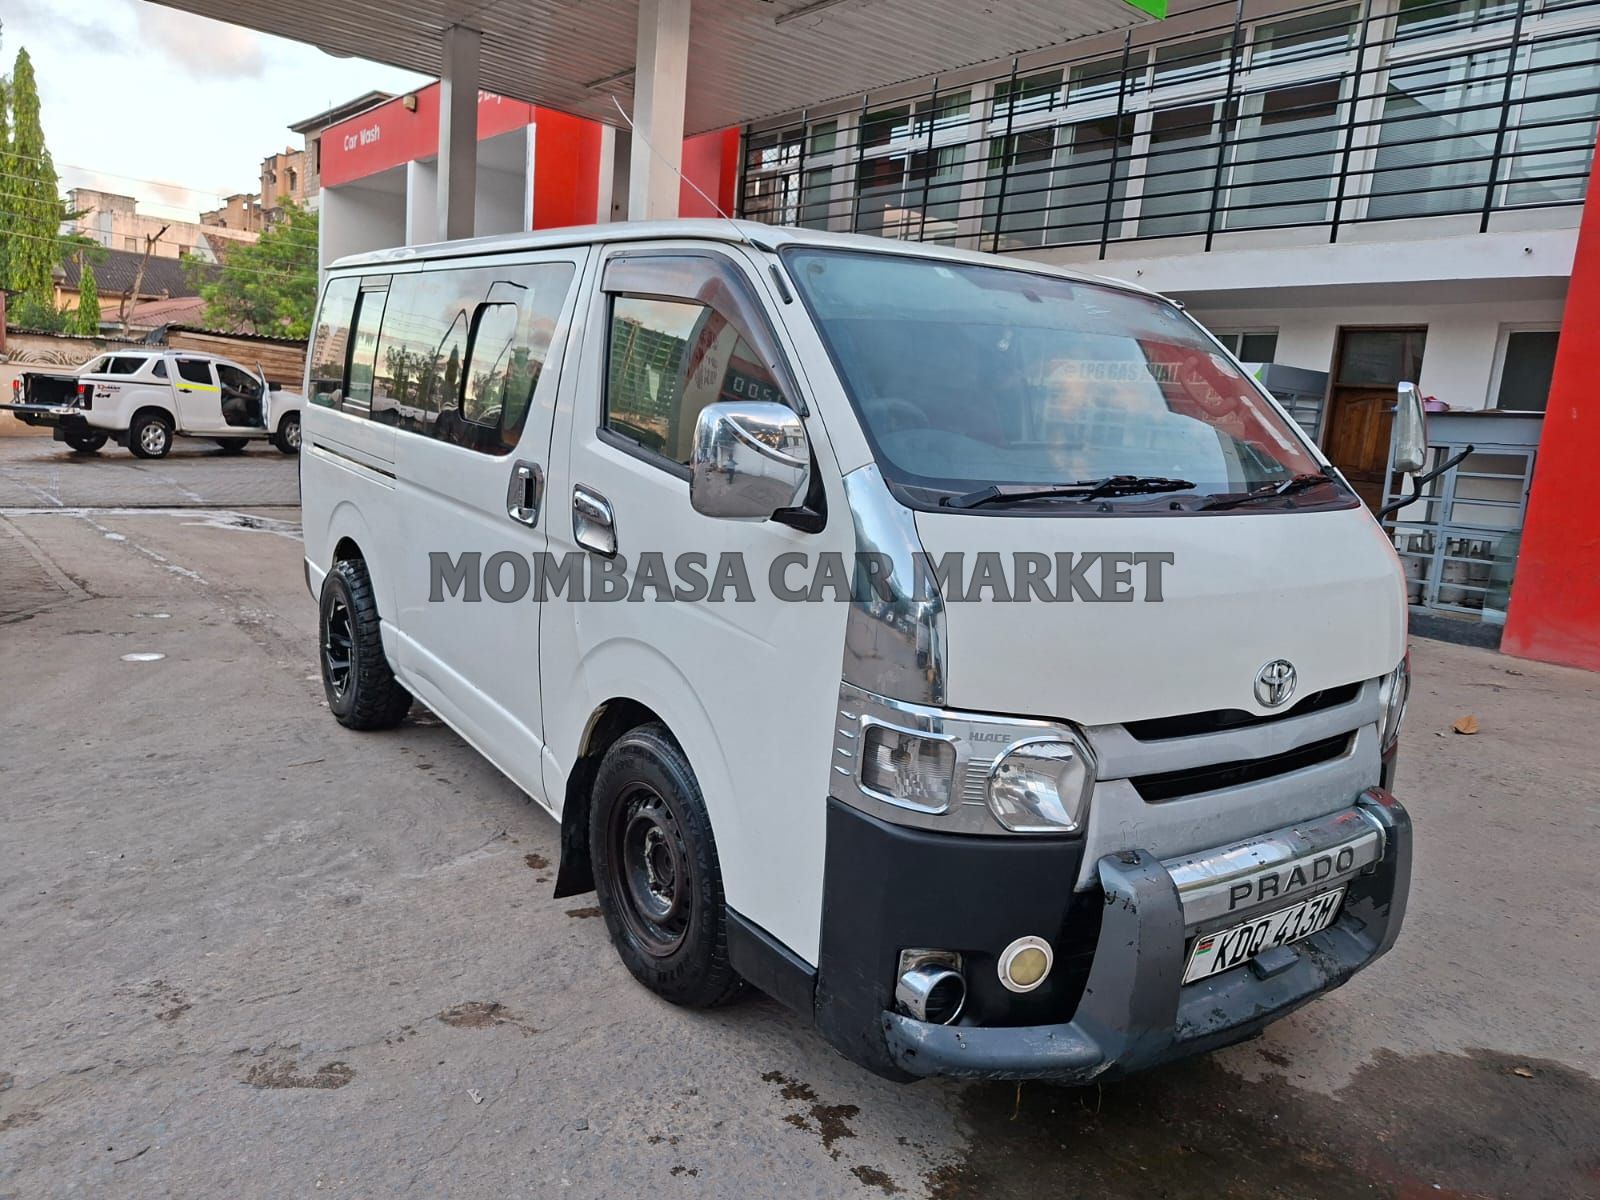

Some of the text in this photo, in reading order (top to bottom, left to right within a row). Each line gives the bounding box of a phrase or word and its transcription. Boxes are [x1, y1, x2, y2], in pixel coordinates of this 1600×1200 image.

[343, 124, 381, 152] Car Wash
[1108, 362, 1138, 381] GAS
[969, 731, 1011, 744] HIACE
[1228, 846, 1354, 910] PRADO
[1210, 894, 1337, 972] KDQ 413M
